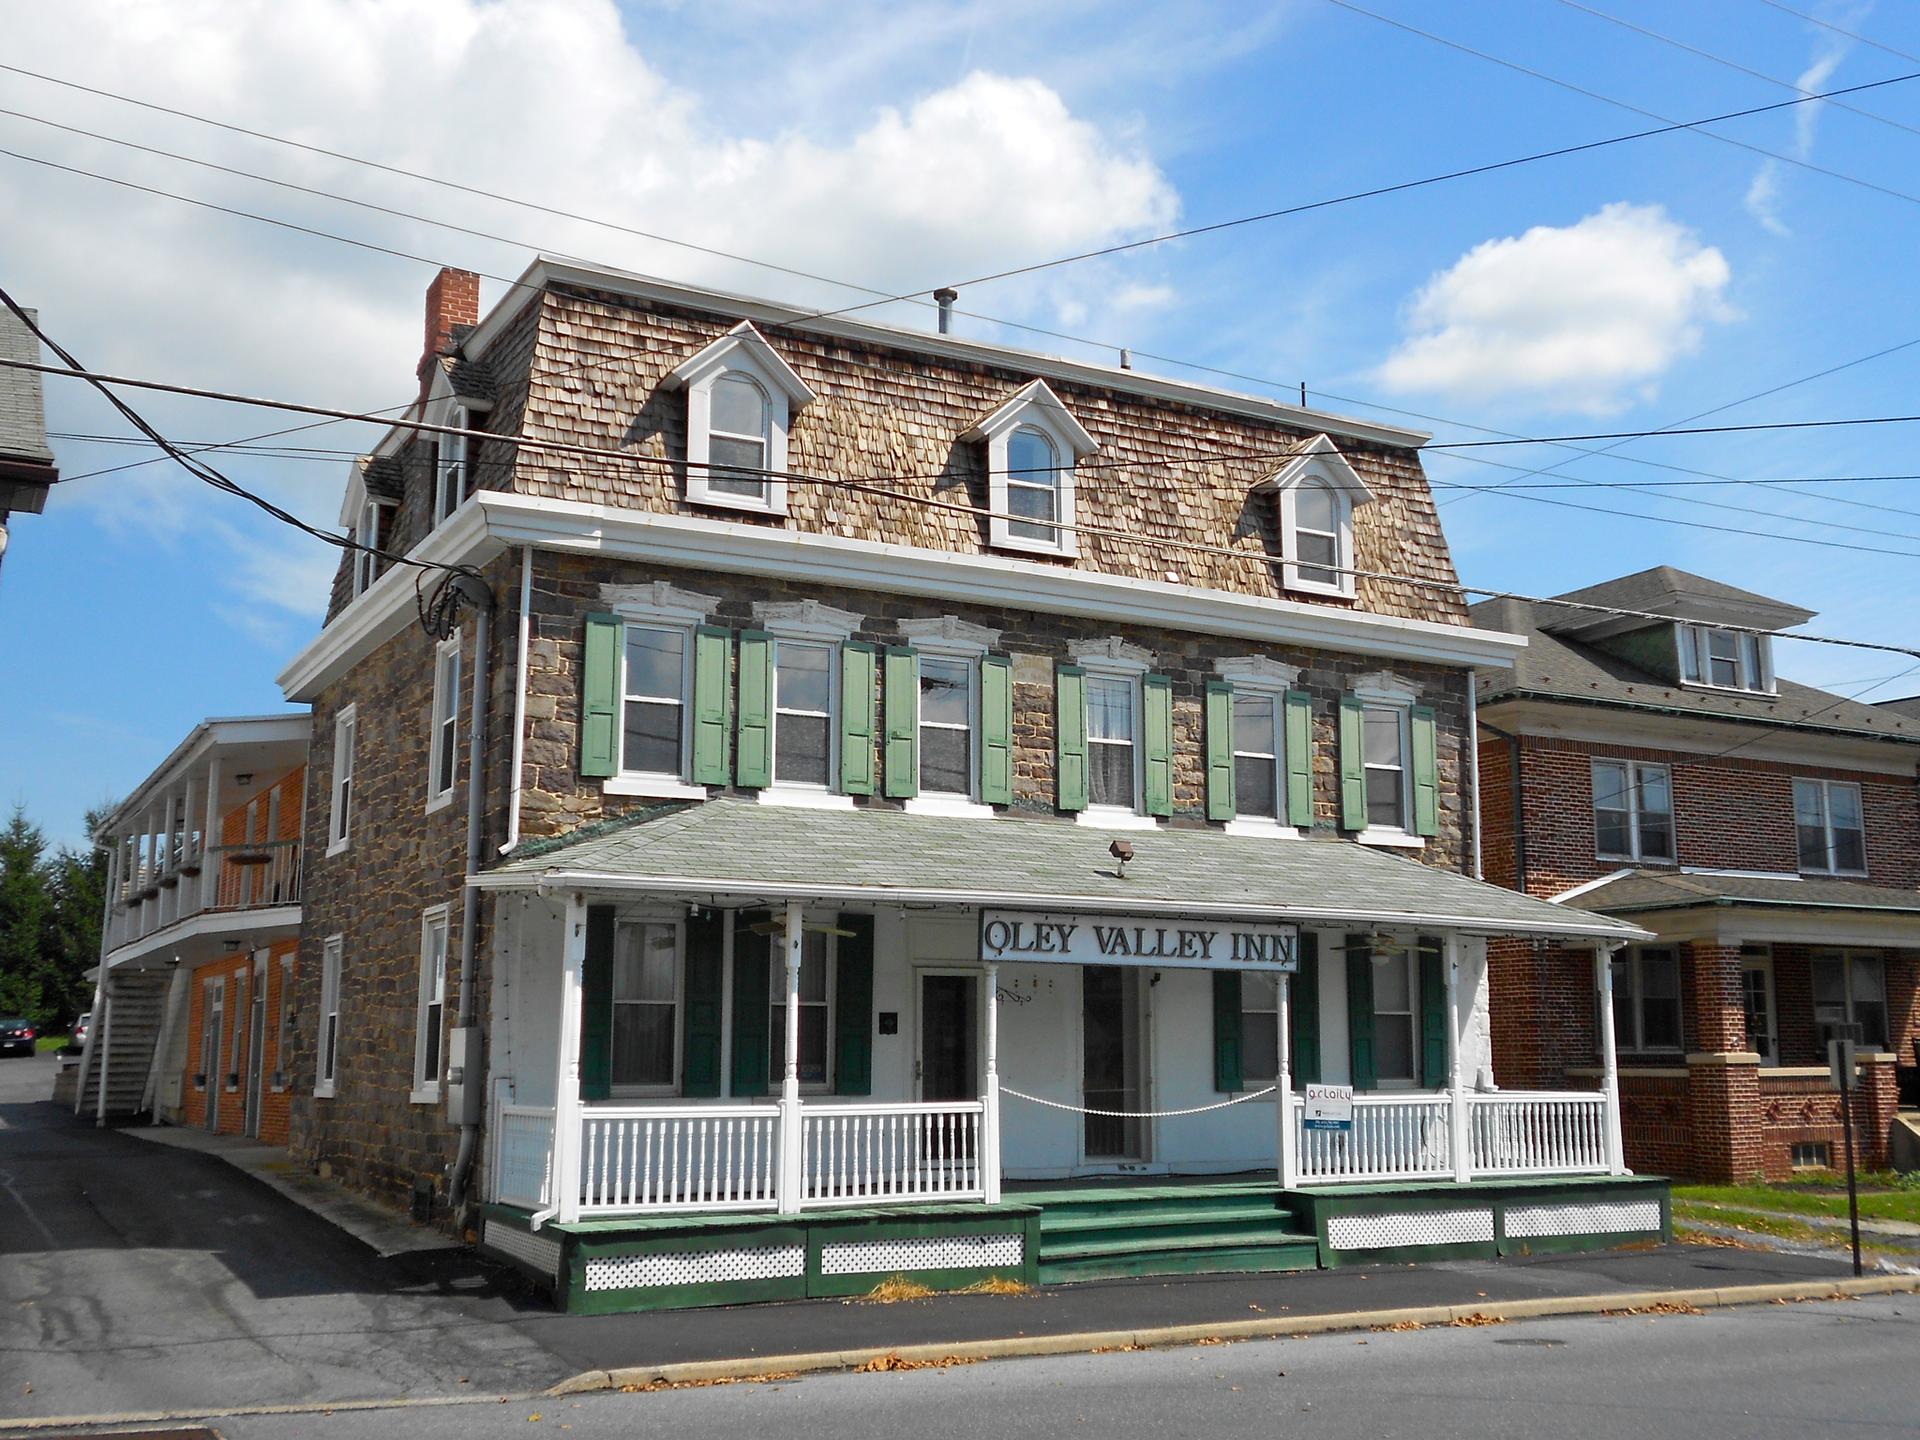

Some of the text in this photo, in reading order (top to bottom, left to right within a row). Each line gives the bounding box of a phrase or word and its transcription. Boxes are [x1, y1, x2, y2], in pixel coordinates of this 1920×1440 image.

[985, 920, 1296, 963] OLEY VALLEY INN
